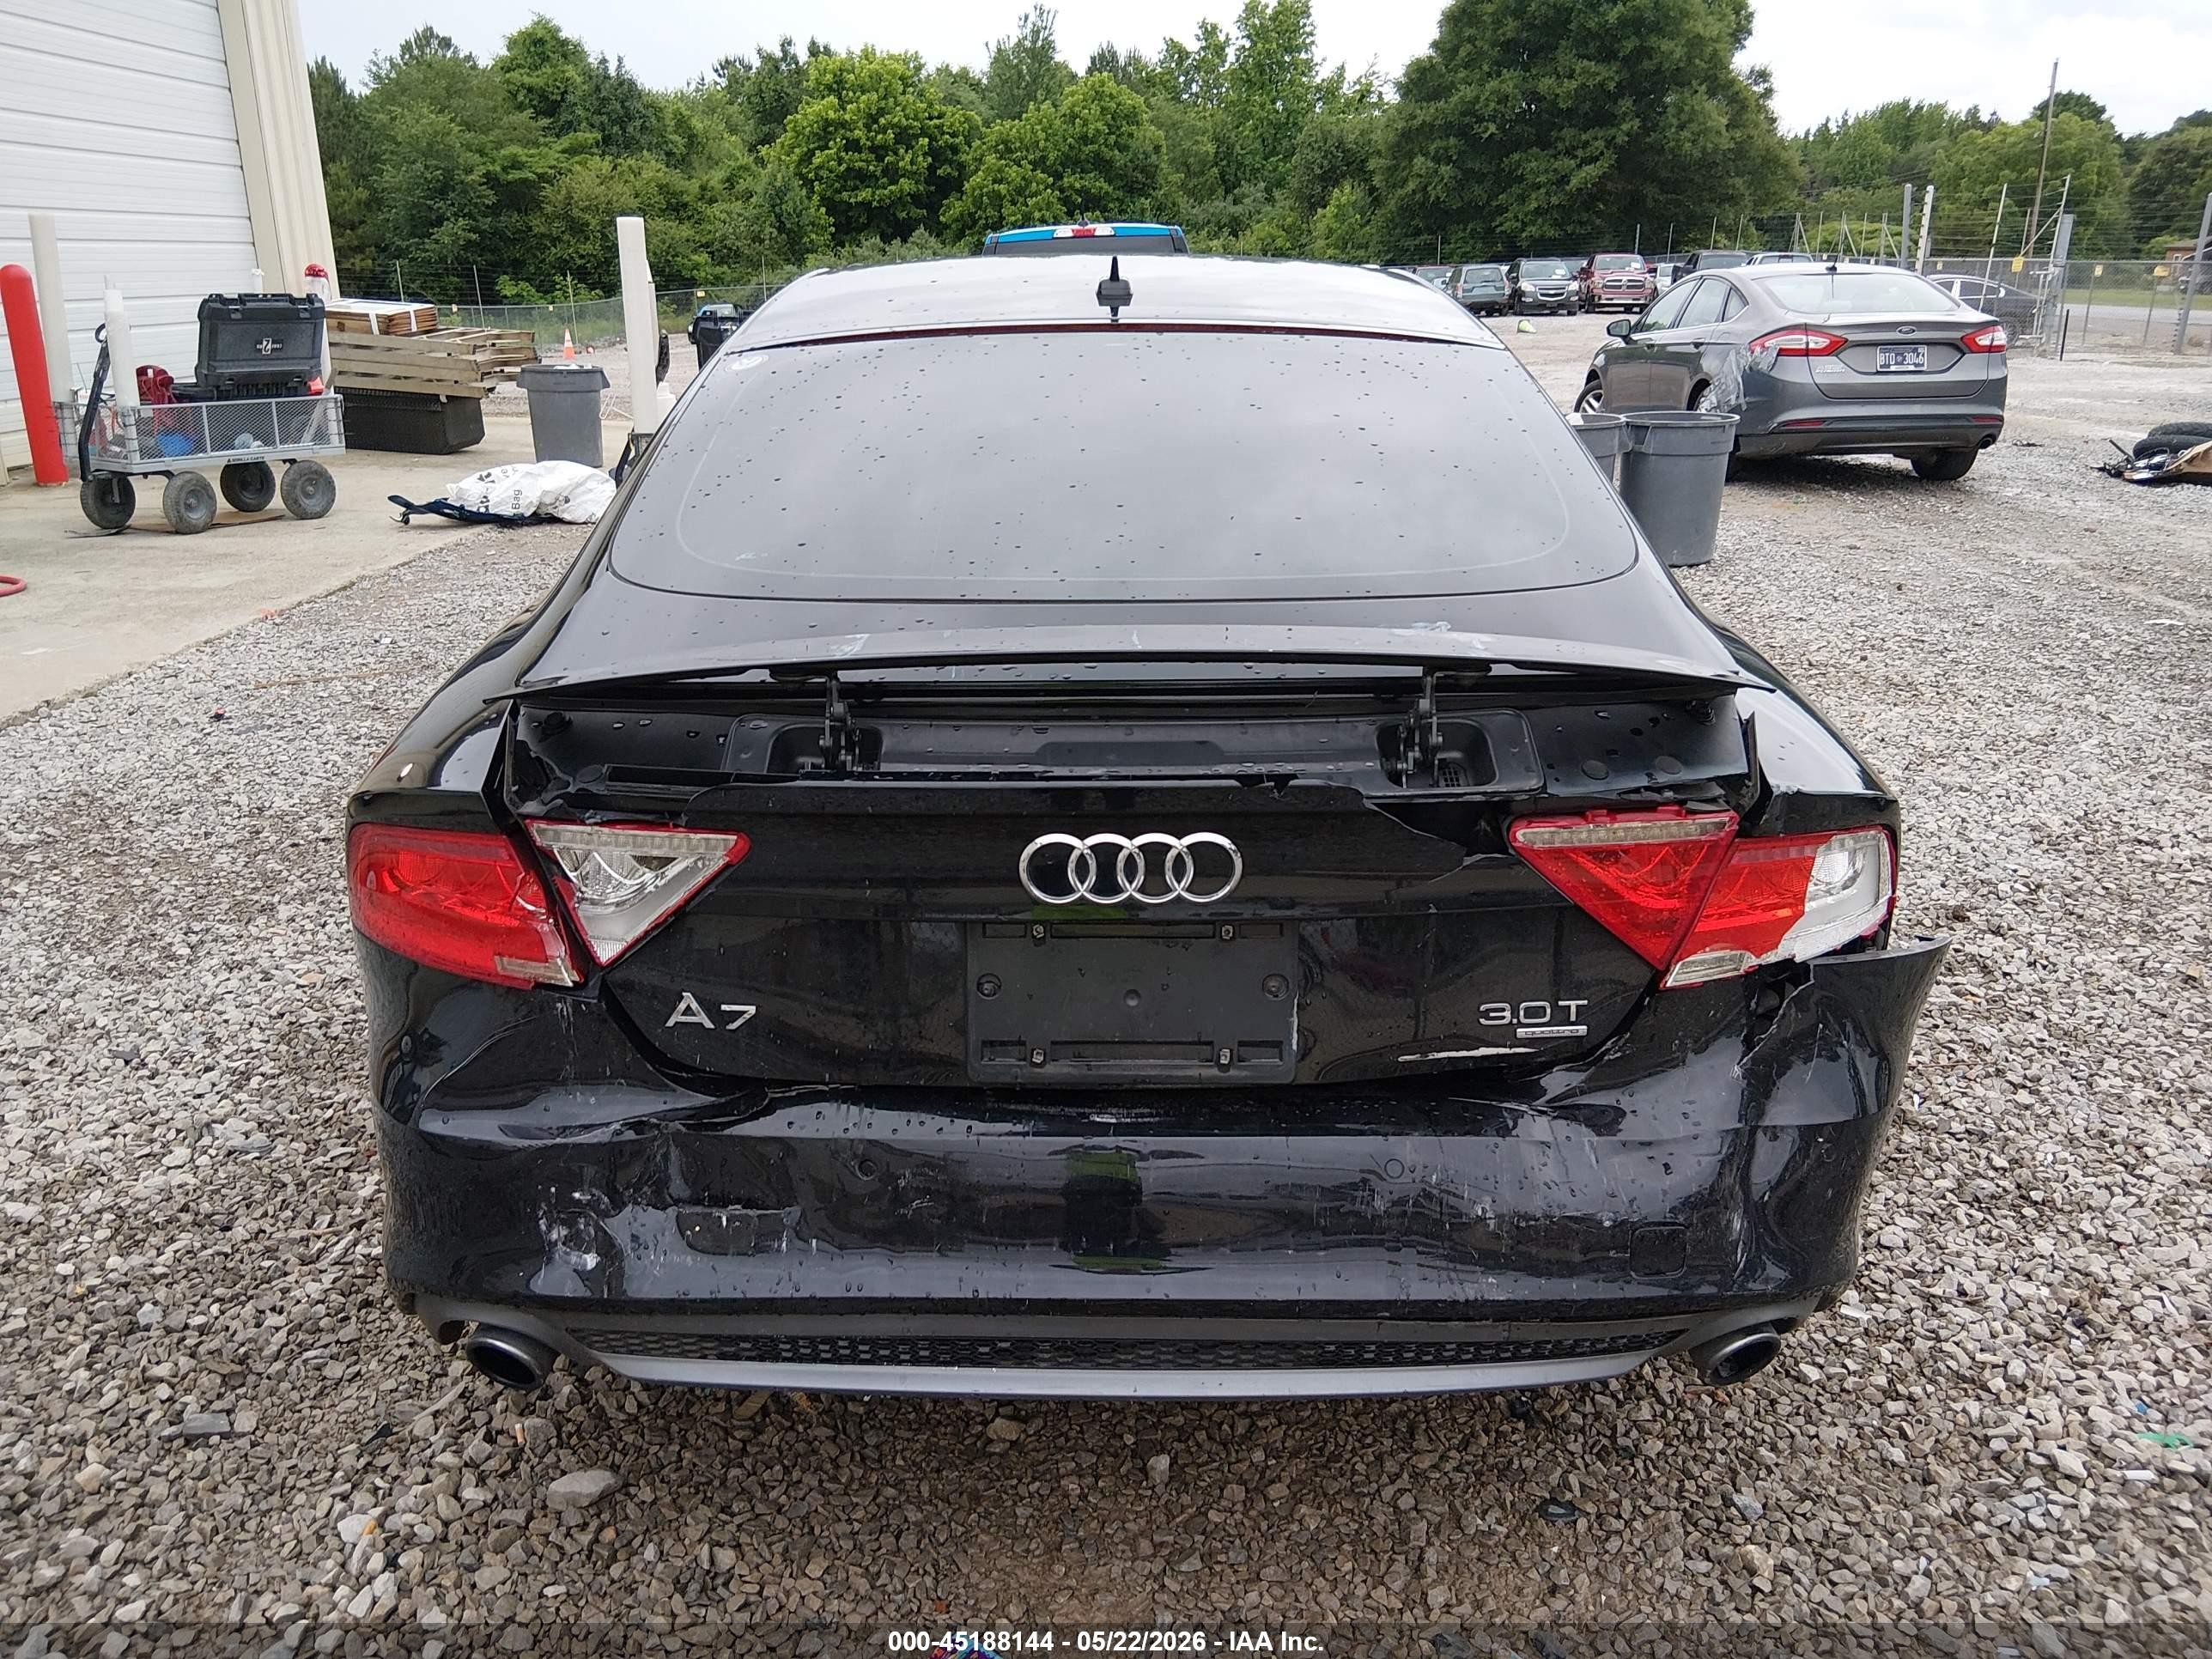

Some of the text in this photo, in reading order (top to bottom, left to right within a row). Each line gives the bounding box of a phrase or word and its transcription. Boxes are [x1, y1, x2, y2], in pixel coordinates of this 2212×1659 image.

[1903, 352, 1924, 364] 3046
[511, 489, 523, 510] Bag
[665, 992, 757, 1030] A7
